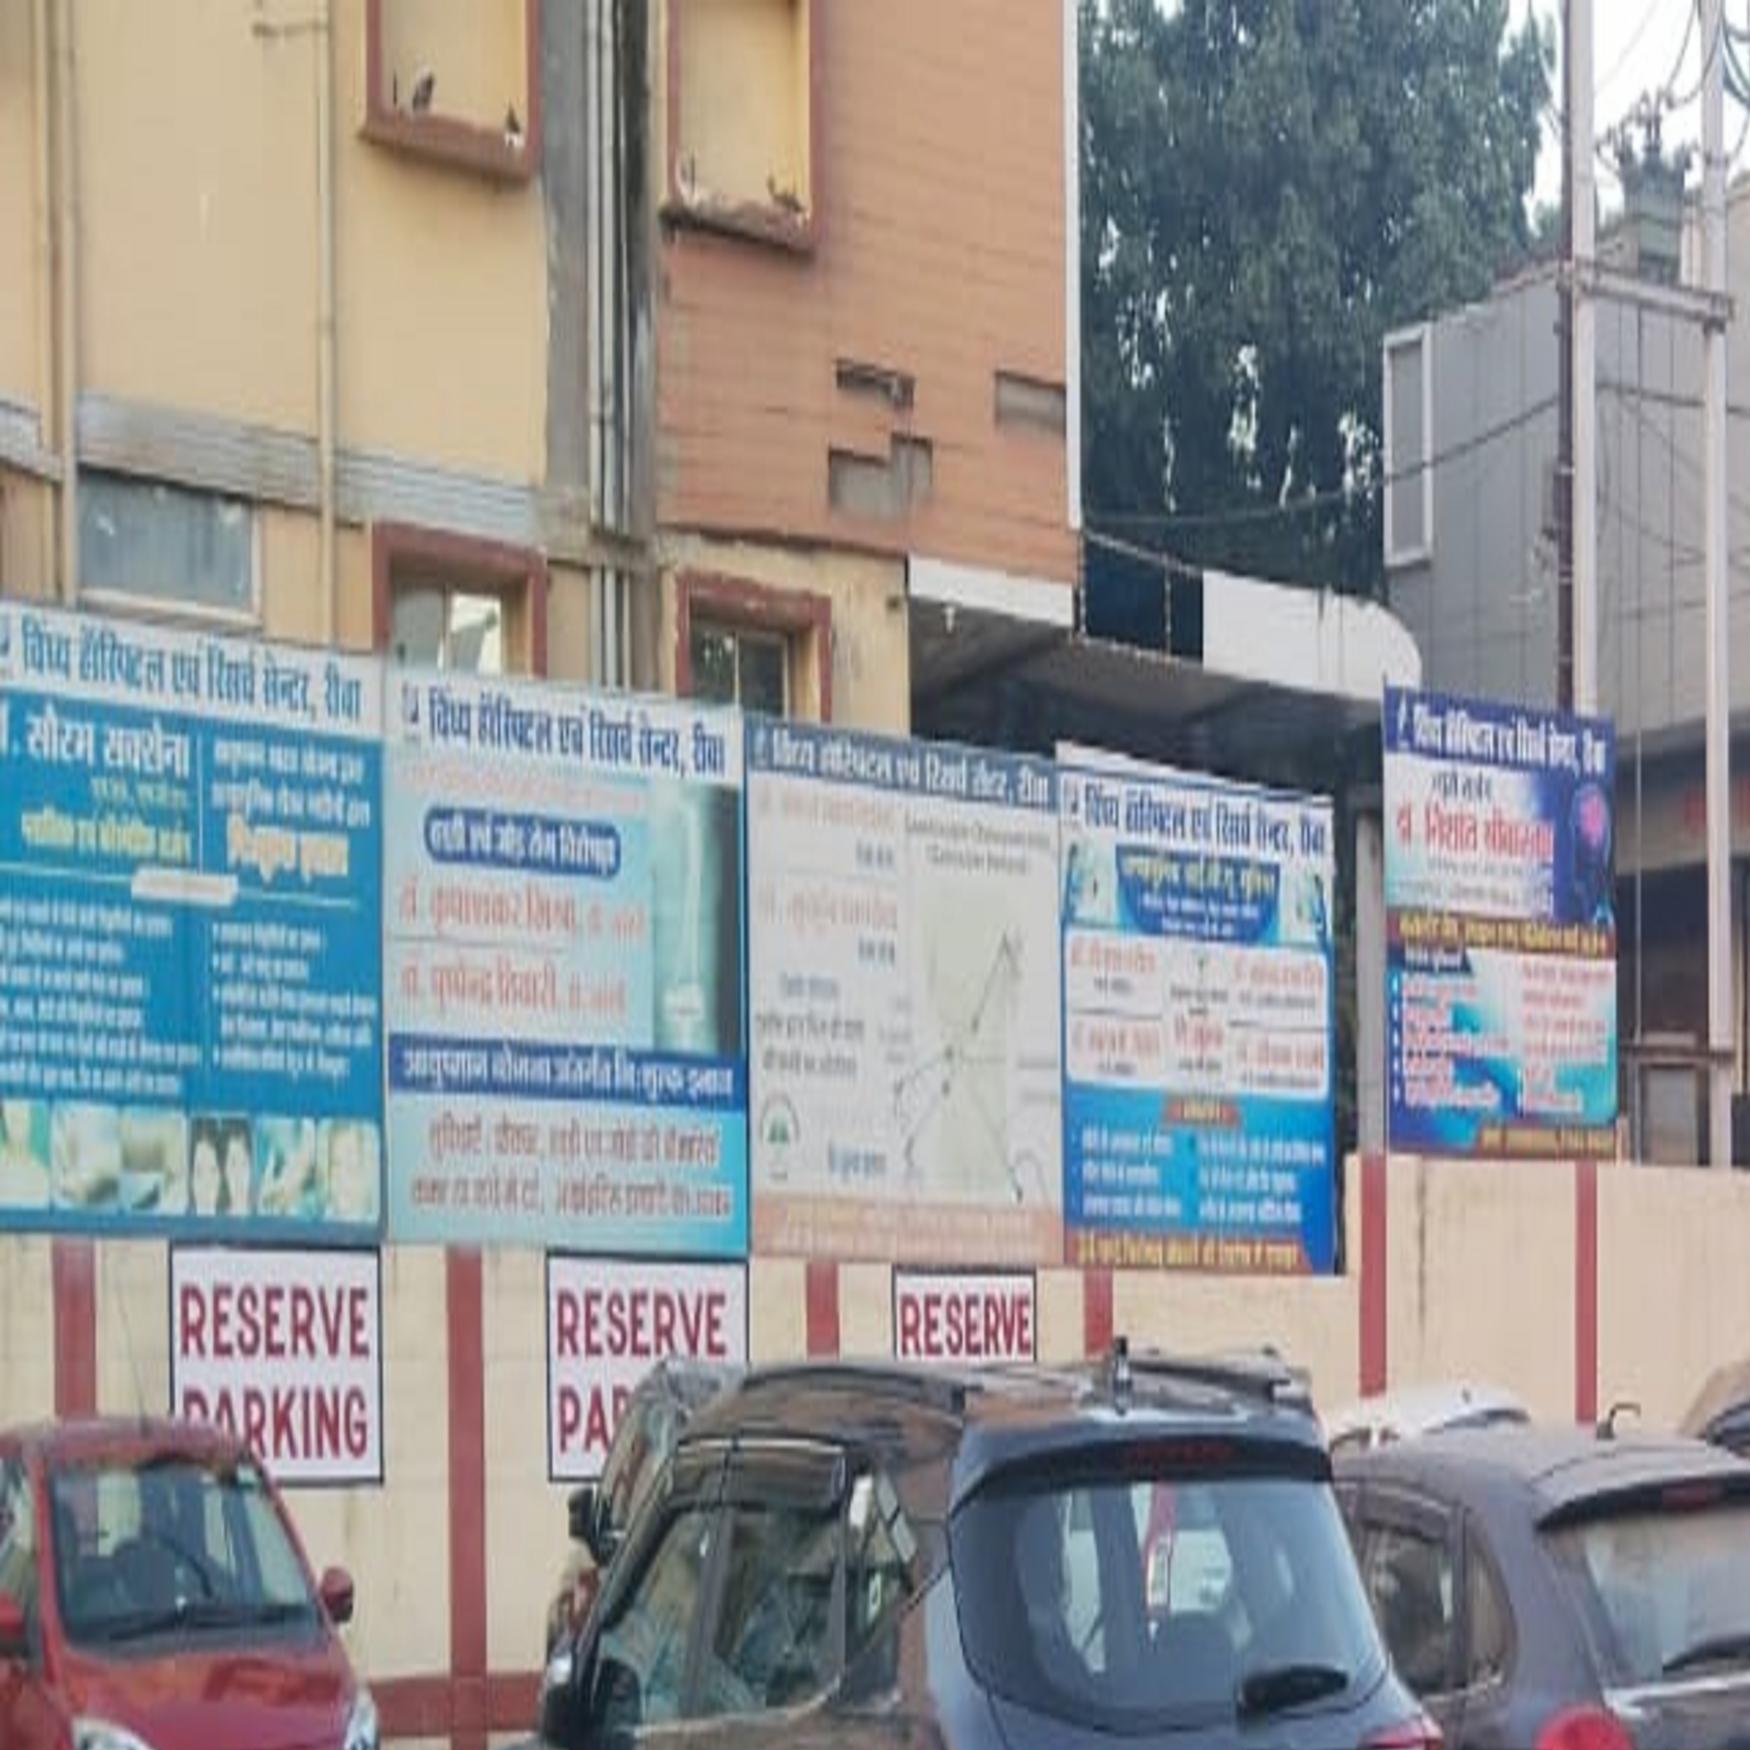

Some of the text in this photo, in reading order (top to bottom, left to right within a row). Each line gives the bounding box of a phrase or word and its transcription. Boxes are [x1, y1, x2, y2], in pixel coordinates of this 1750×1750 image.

[180, 1284, 370, 1359] RESERVE
[557, 1290, 727, 1357] RESERVE
[901, 1294, 1032, 1356] RESERVE
